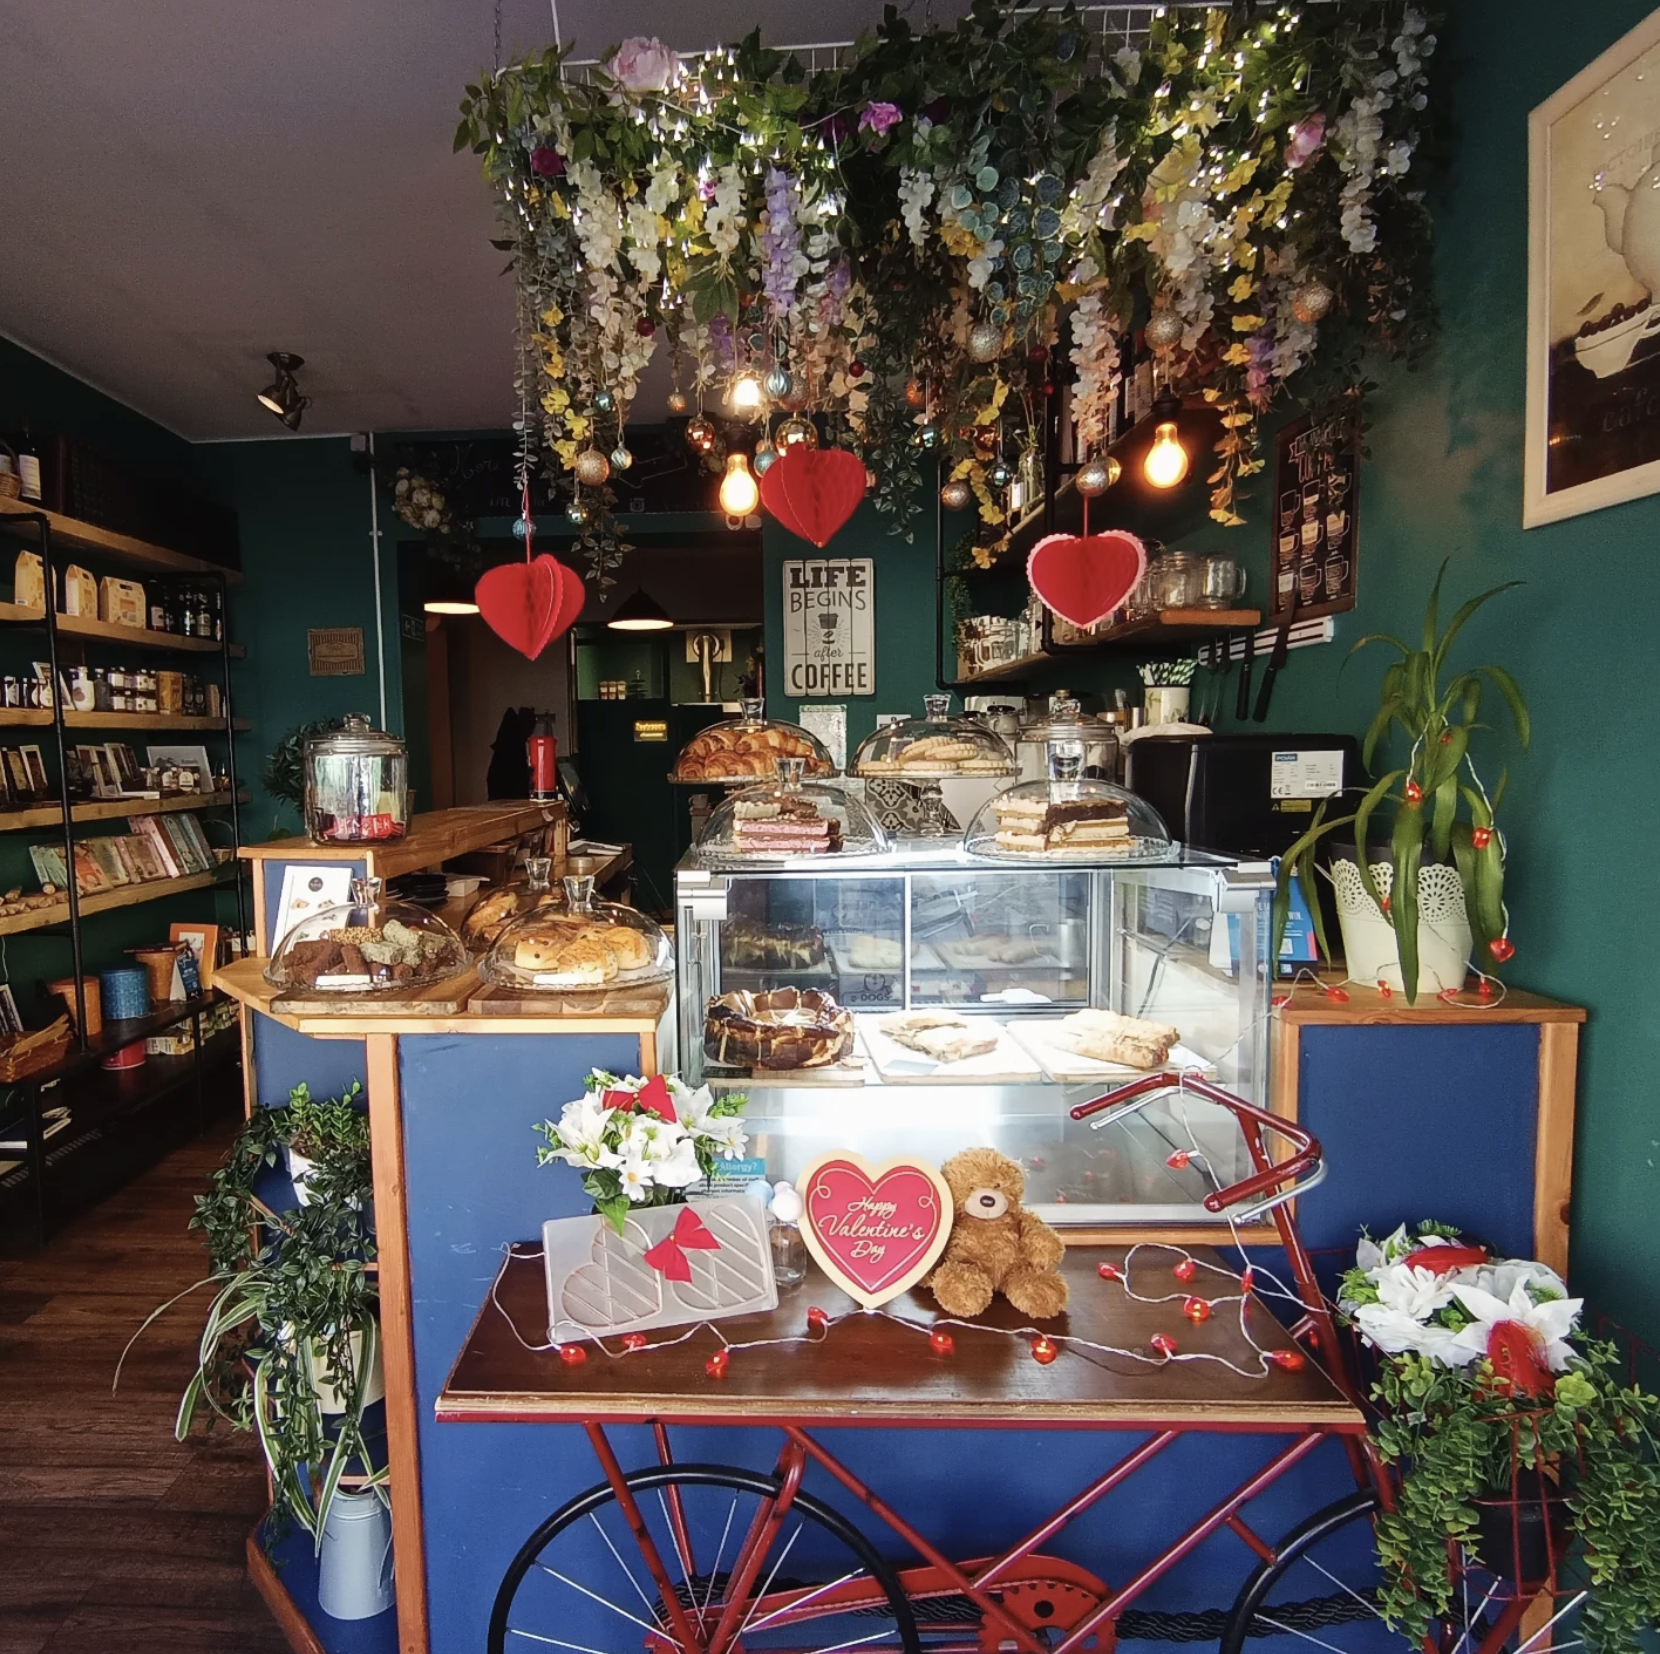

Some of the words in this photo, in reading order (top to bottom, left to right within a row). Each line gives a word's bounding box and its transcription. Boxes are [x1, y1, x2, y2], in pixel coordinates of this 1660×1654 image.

[790, 566, 866, 588] LIFE
[790, 590, 866, 613] BEGINS
[814, 646, 844, 662] after
[791, 663, 867, 689] COFFEE
[720, 1162, 758, 1173] Allergy?
[847, 1196, 897, 1219] Happy
[818, 1213, 925, 1240] Valentine's
[850, 1240, 886, 1264] Day
